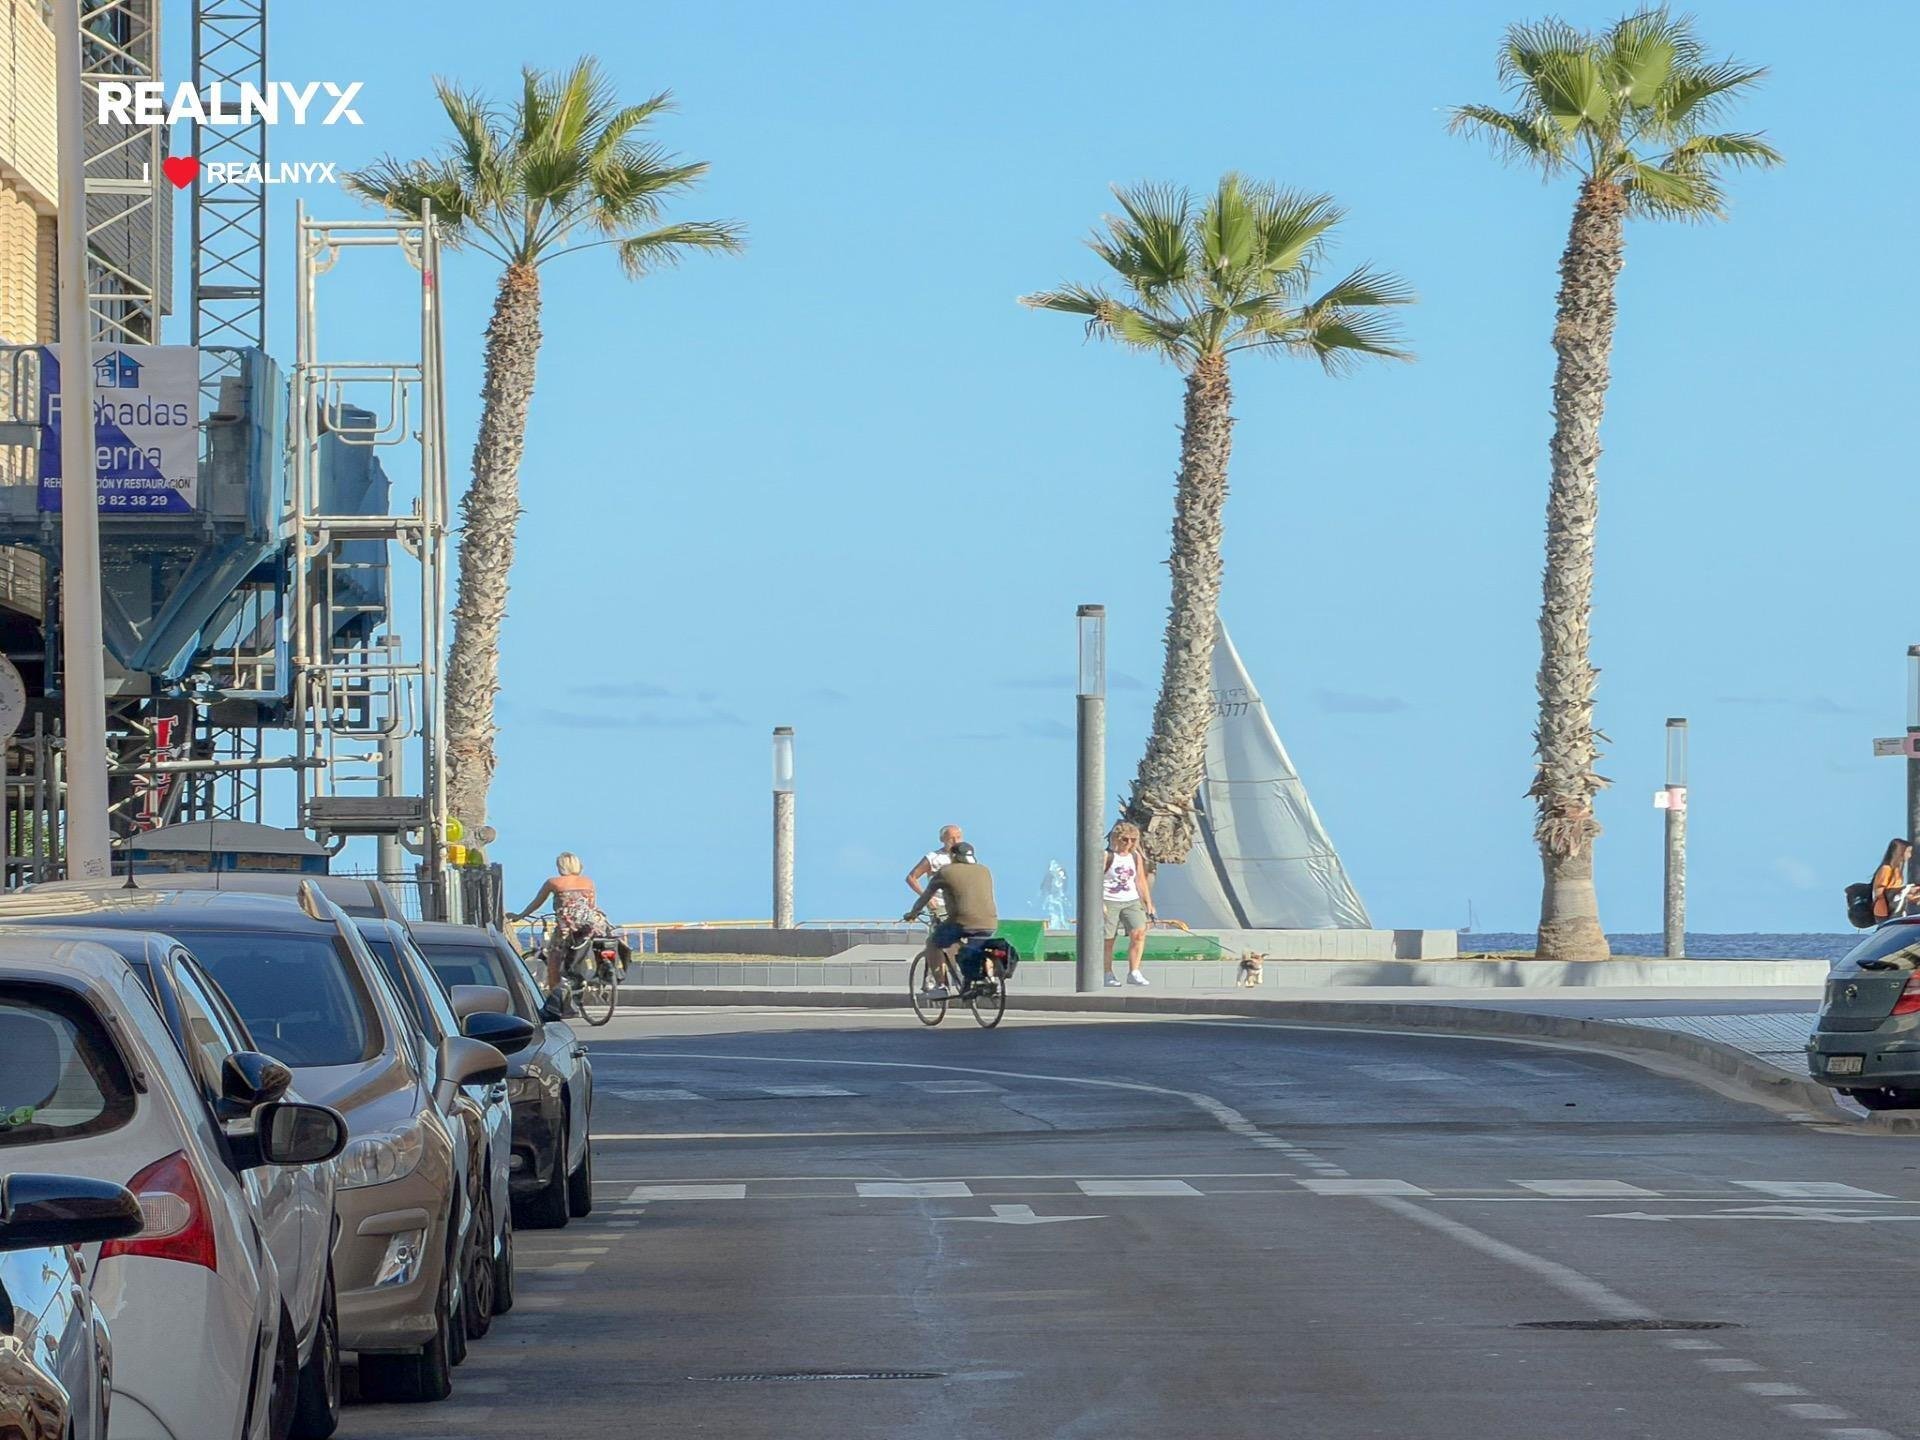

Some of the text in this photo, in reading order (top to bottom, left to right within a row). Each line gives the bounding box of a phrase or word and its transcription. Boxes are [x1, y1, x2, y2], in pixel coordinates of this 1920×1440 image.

[48, 393, 188, 426] Fhadas
[96, 446, 162, 470] erna
[117, 478, 124, 489] Y
[109, 495, 127, 506] 82
[130, 495, 147, 506] 38
[150, 495, 168, 506] 29
